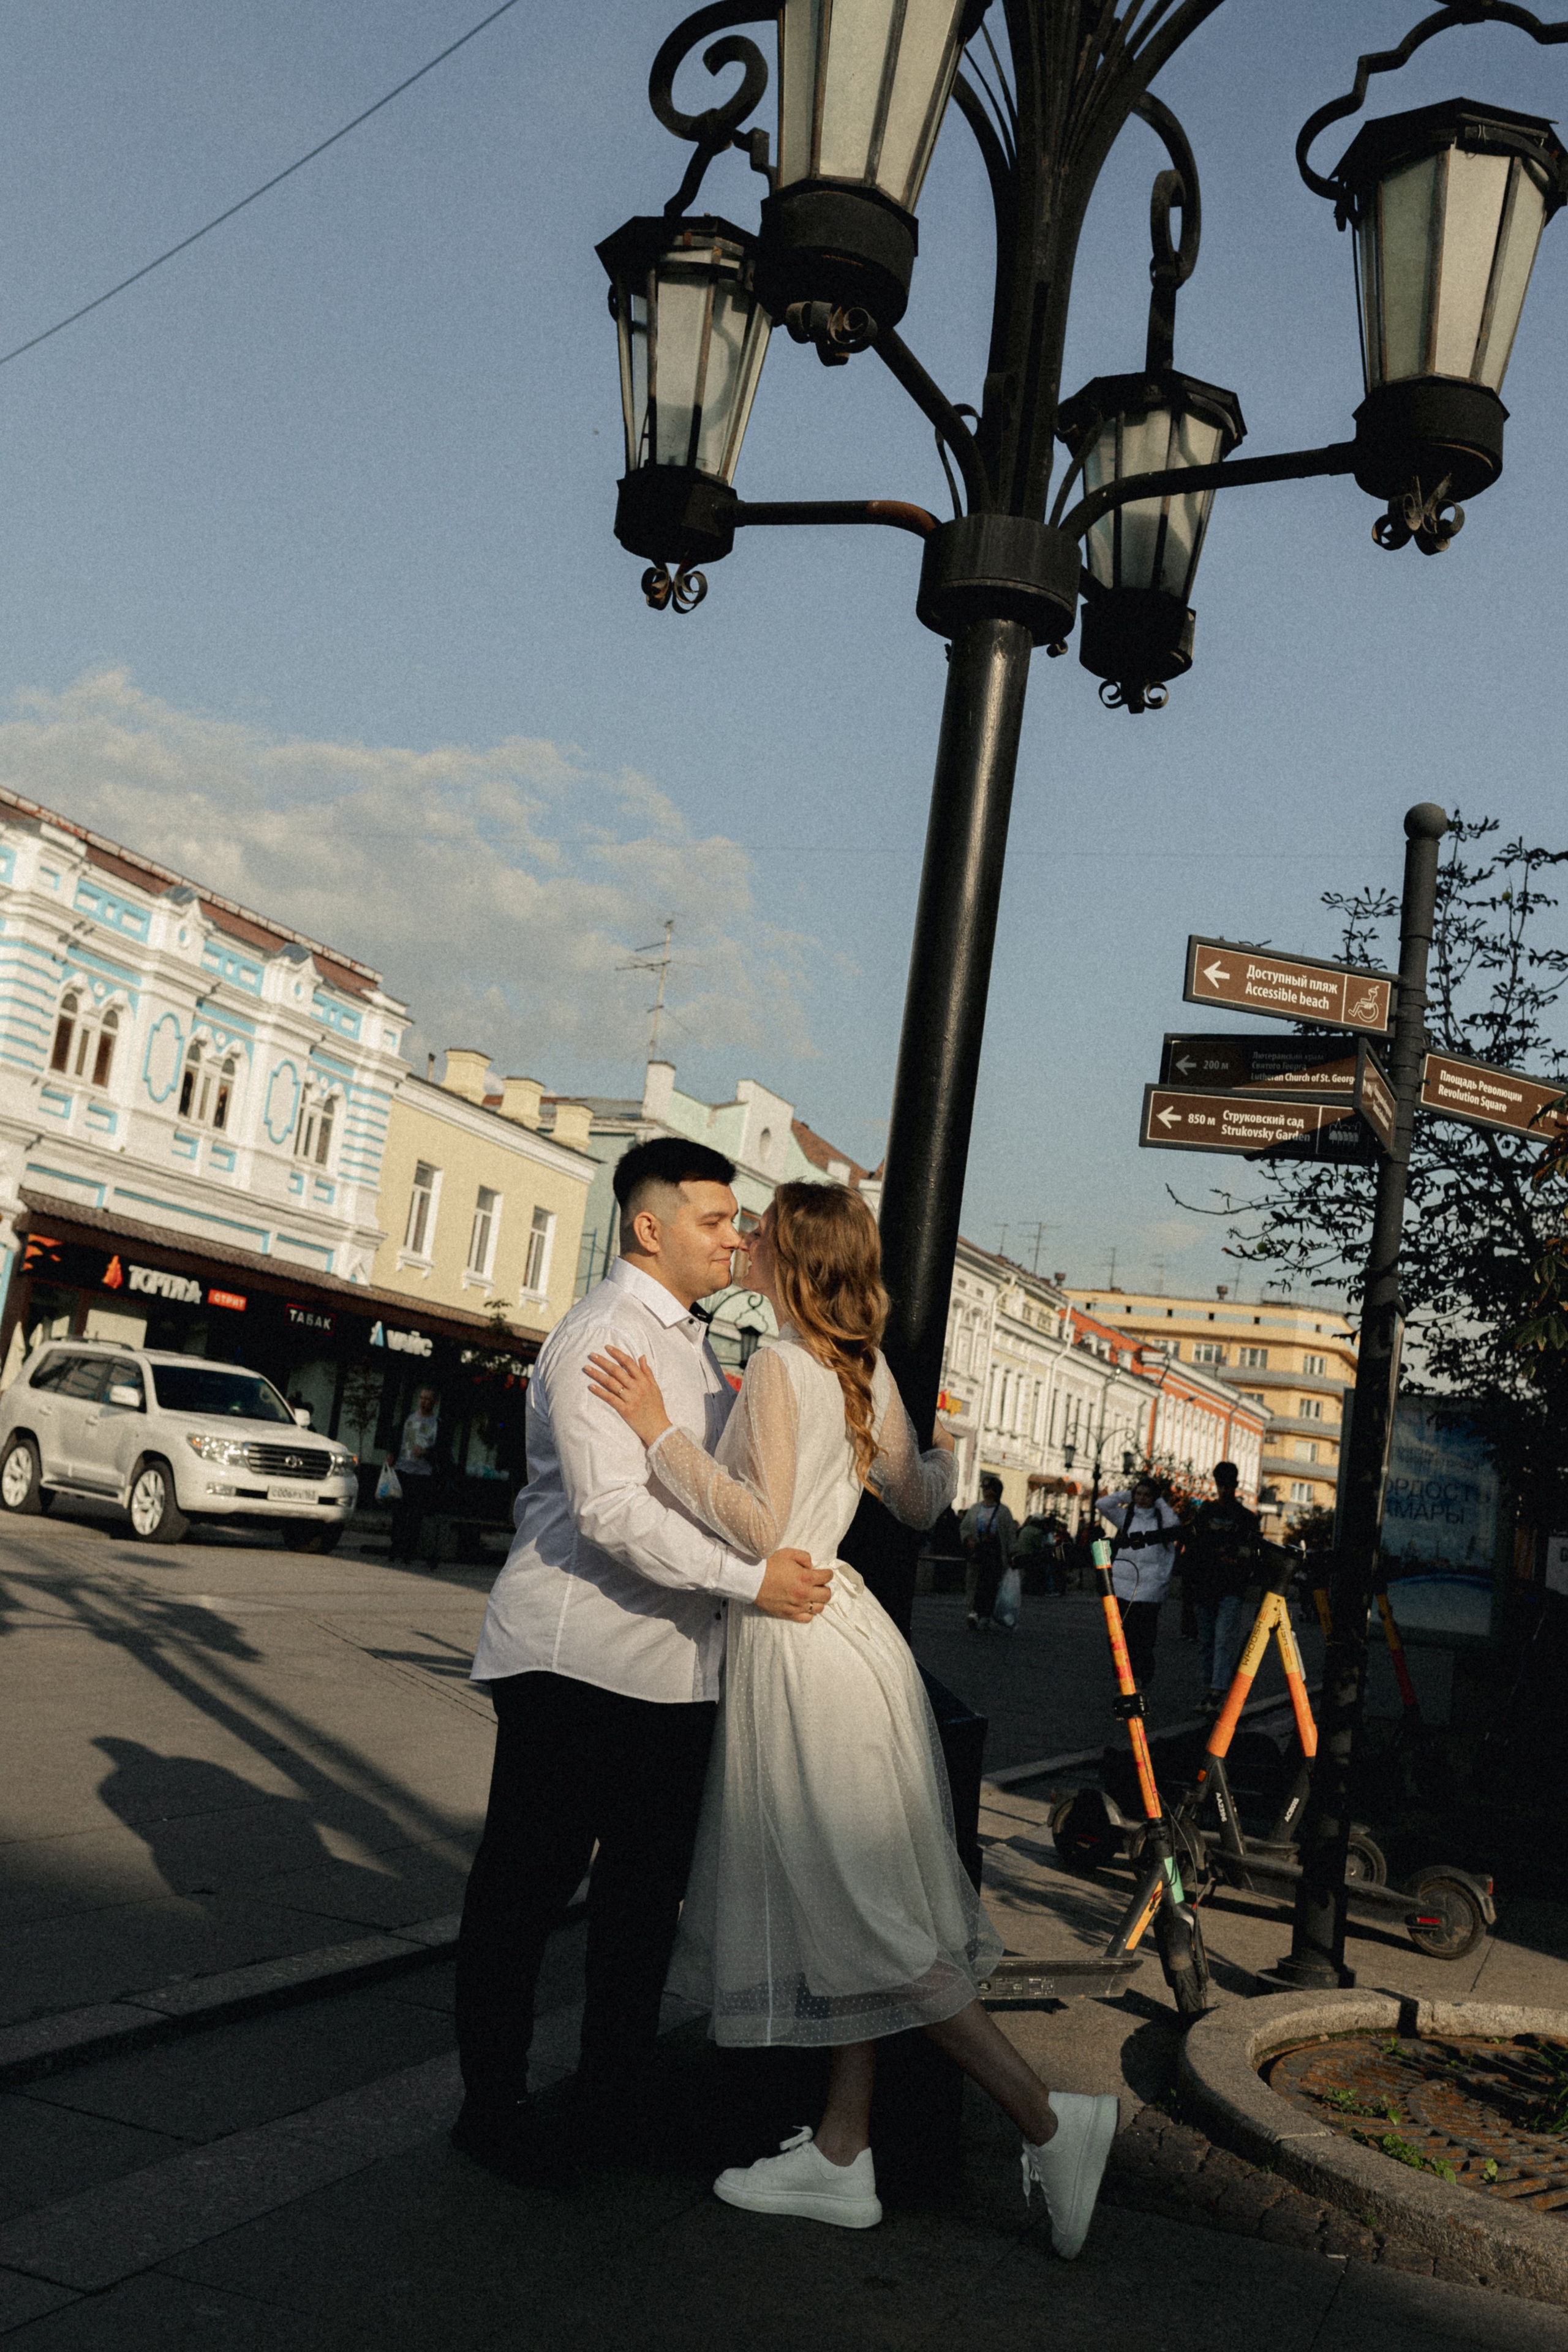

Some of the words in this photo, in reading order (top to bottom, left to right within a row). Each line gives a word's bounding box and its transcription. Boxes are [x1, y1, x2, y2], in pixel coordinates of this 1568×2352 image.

[1246, 964, 1308, 988] Доступный
[1310, 979, 1338, 994] пляж
[1245, 982, 1297, 1003] Accessible
[1299, 992, 1329, 1010] beach
[1204, 1060, 1219, 1070] 200
[1285, 1073, 1310, 1082] Church
[1311, 1073, 1321, 1082] of
[1321, 1074, 1330, 1082] St.
[1332, 1074, 1355, 1085] Georg
[1440, 1069, 1477, 1090] Площадь
[1479, 1080, 1523, 1102] Революции
[1438, 1084, 1479, 1105] Revolution
[1480, 1097, 1507, 1112] Square
[1188, 1113, 1206, 1125] 850
[1207, 1117, 1216, 1125] м
[1223, 1110, 1285, 1126] Струковский
[1287, 1118, 1305, 1129] сад
[1221, 1124, 1273, 1141] Strukovsky
[1275, 1129, 1311, 1142] Garden
[289, 1309, 331, 1330] ТАБАК
[1241, 1619, 1264, 1666] WHOOSH
